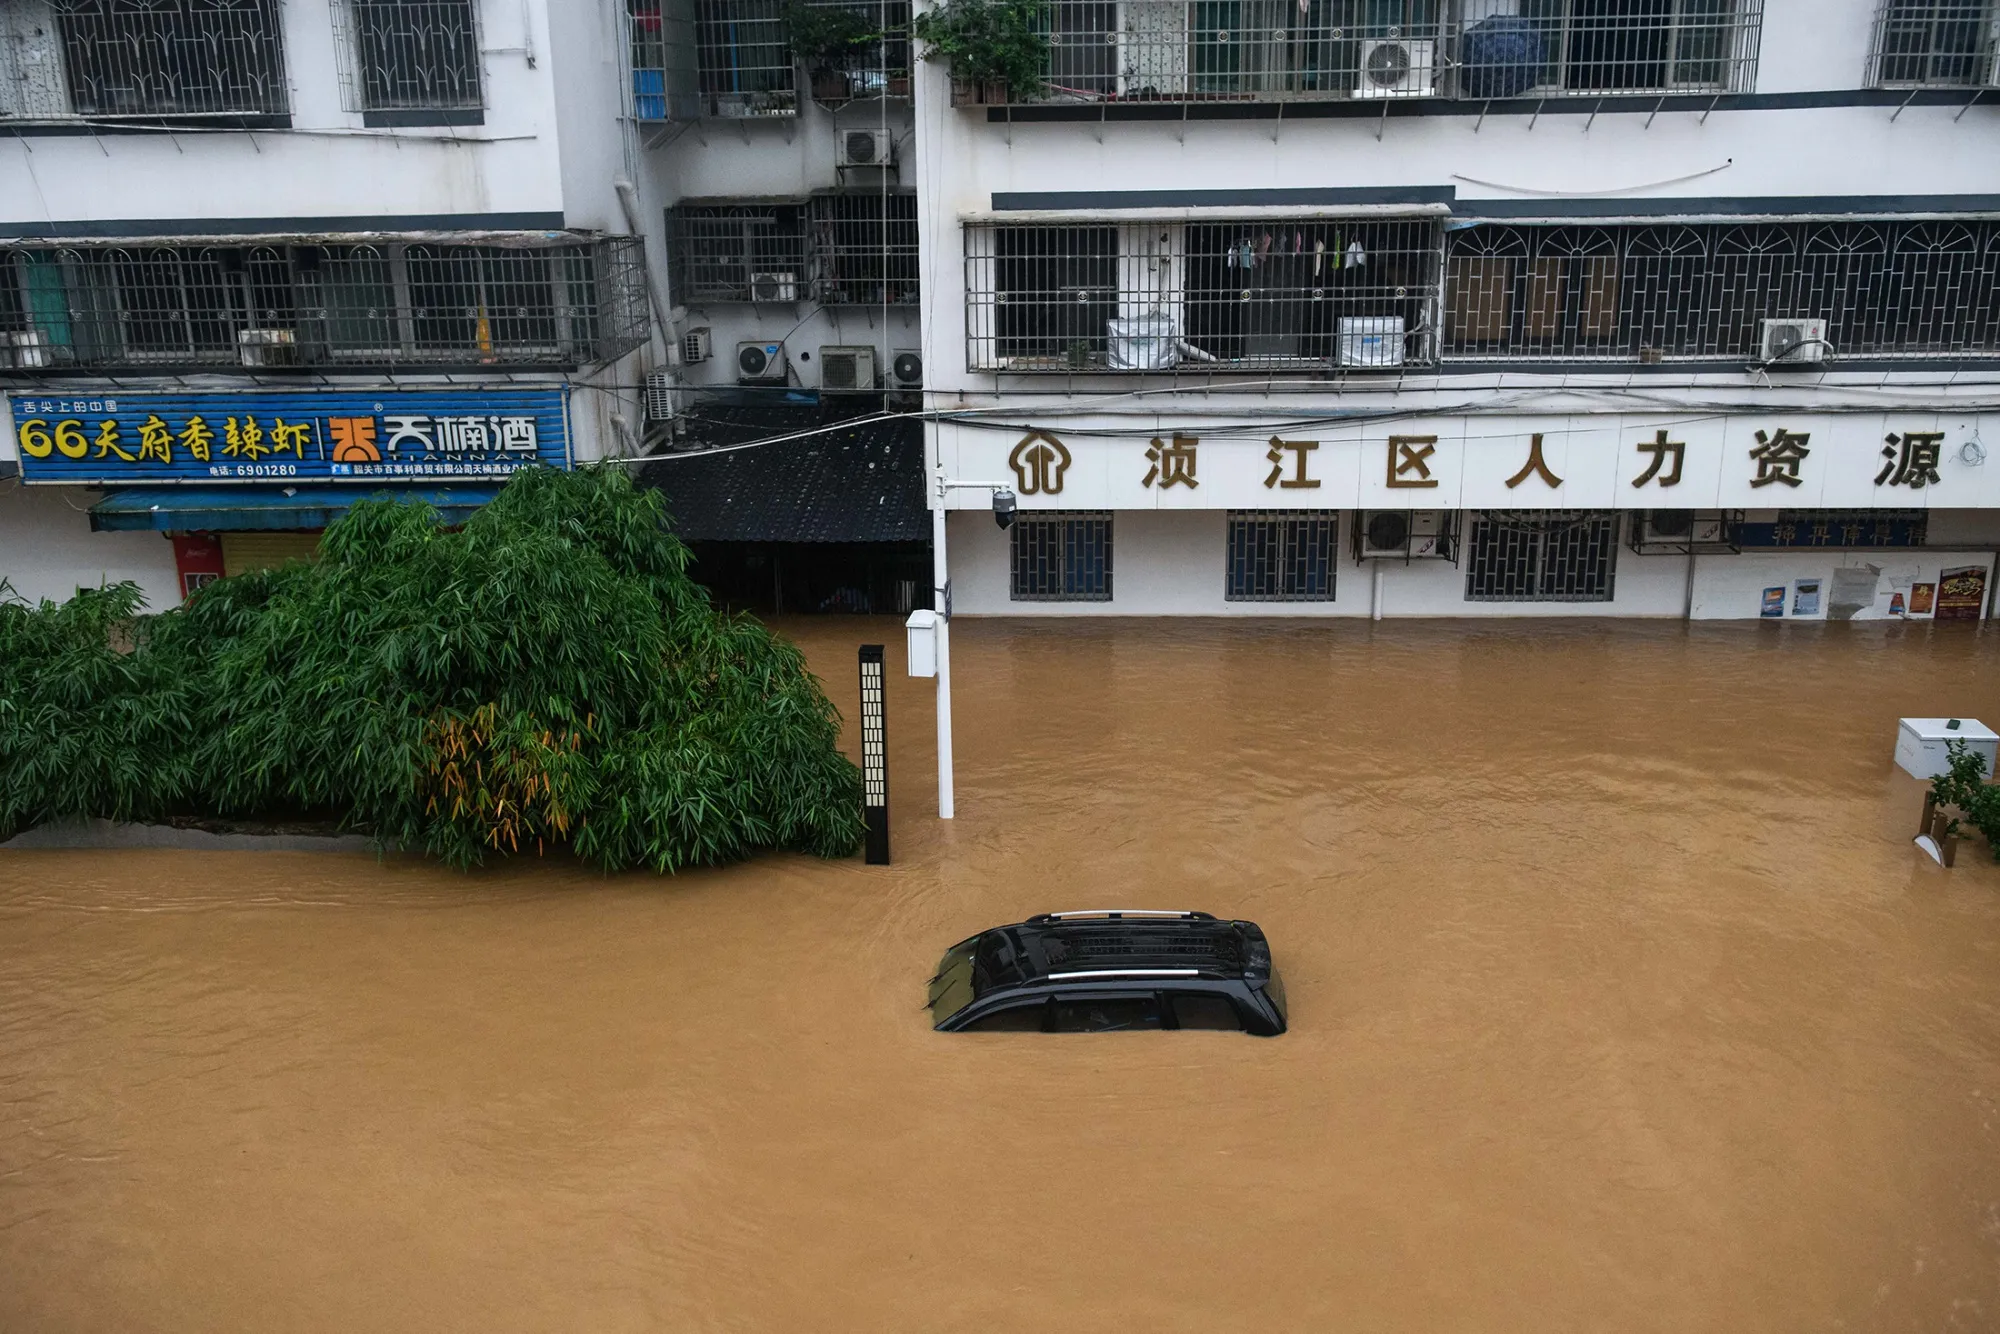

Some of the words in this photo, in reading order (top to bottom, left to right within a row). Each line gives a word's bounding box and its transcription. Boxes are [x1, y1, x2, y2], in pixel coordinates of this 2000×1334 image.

[23, 400, 118, 413] 舌尖上的中国
[19, 414, 312, 464] 66天府香辣虾
[383, 415, 538, 451] 天楠酒
[389, 453, 537, 461] TIANNAN
[1142, 428, 1945, 489] 浈江区人力资源
[237, 465, 297, 476] 6901280
[353, 463, 541, 475] 韶关市百事利商贸有限公司天楠酒业
